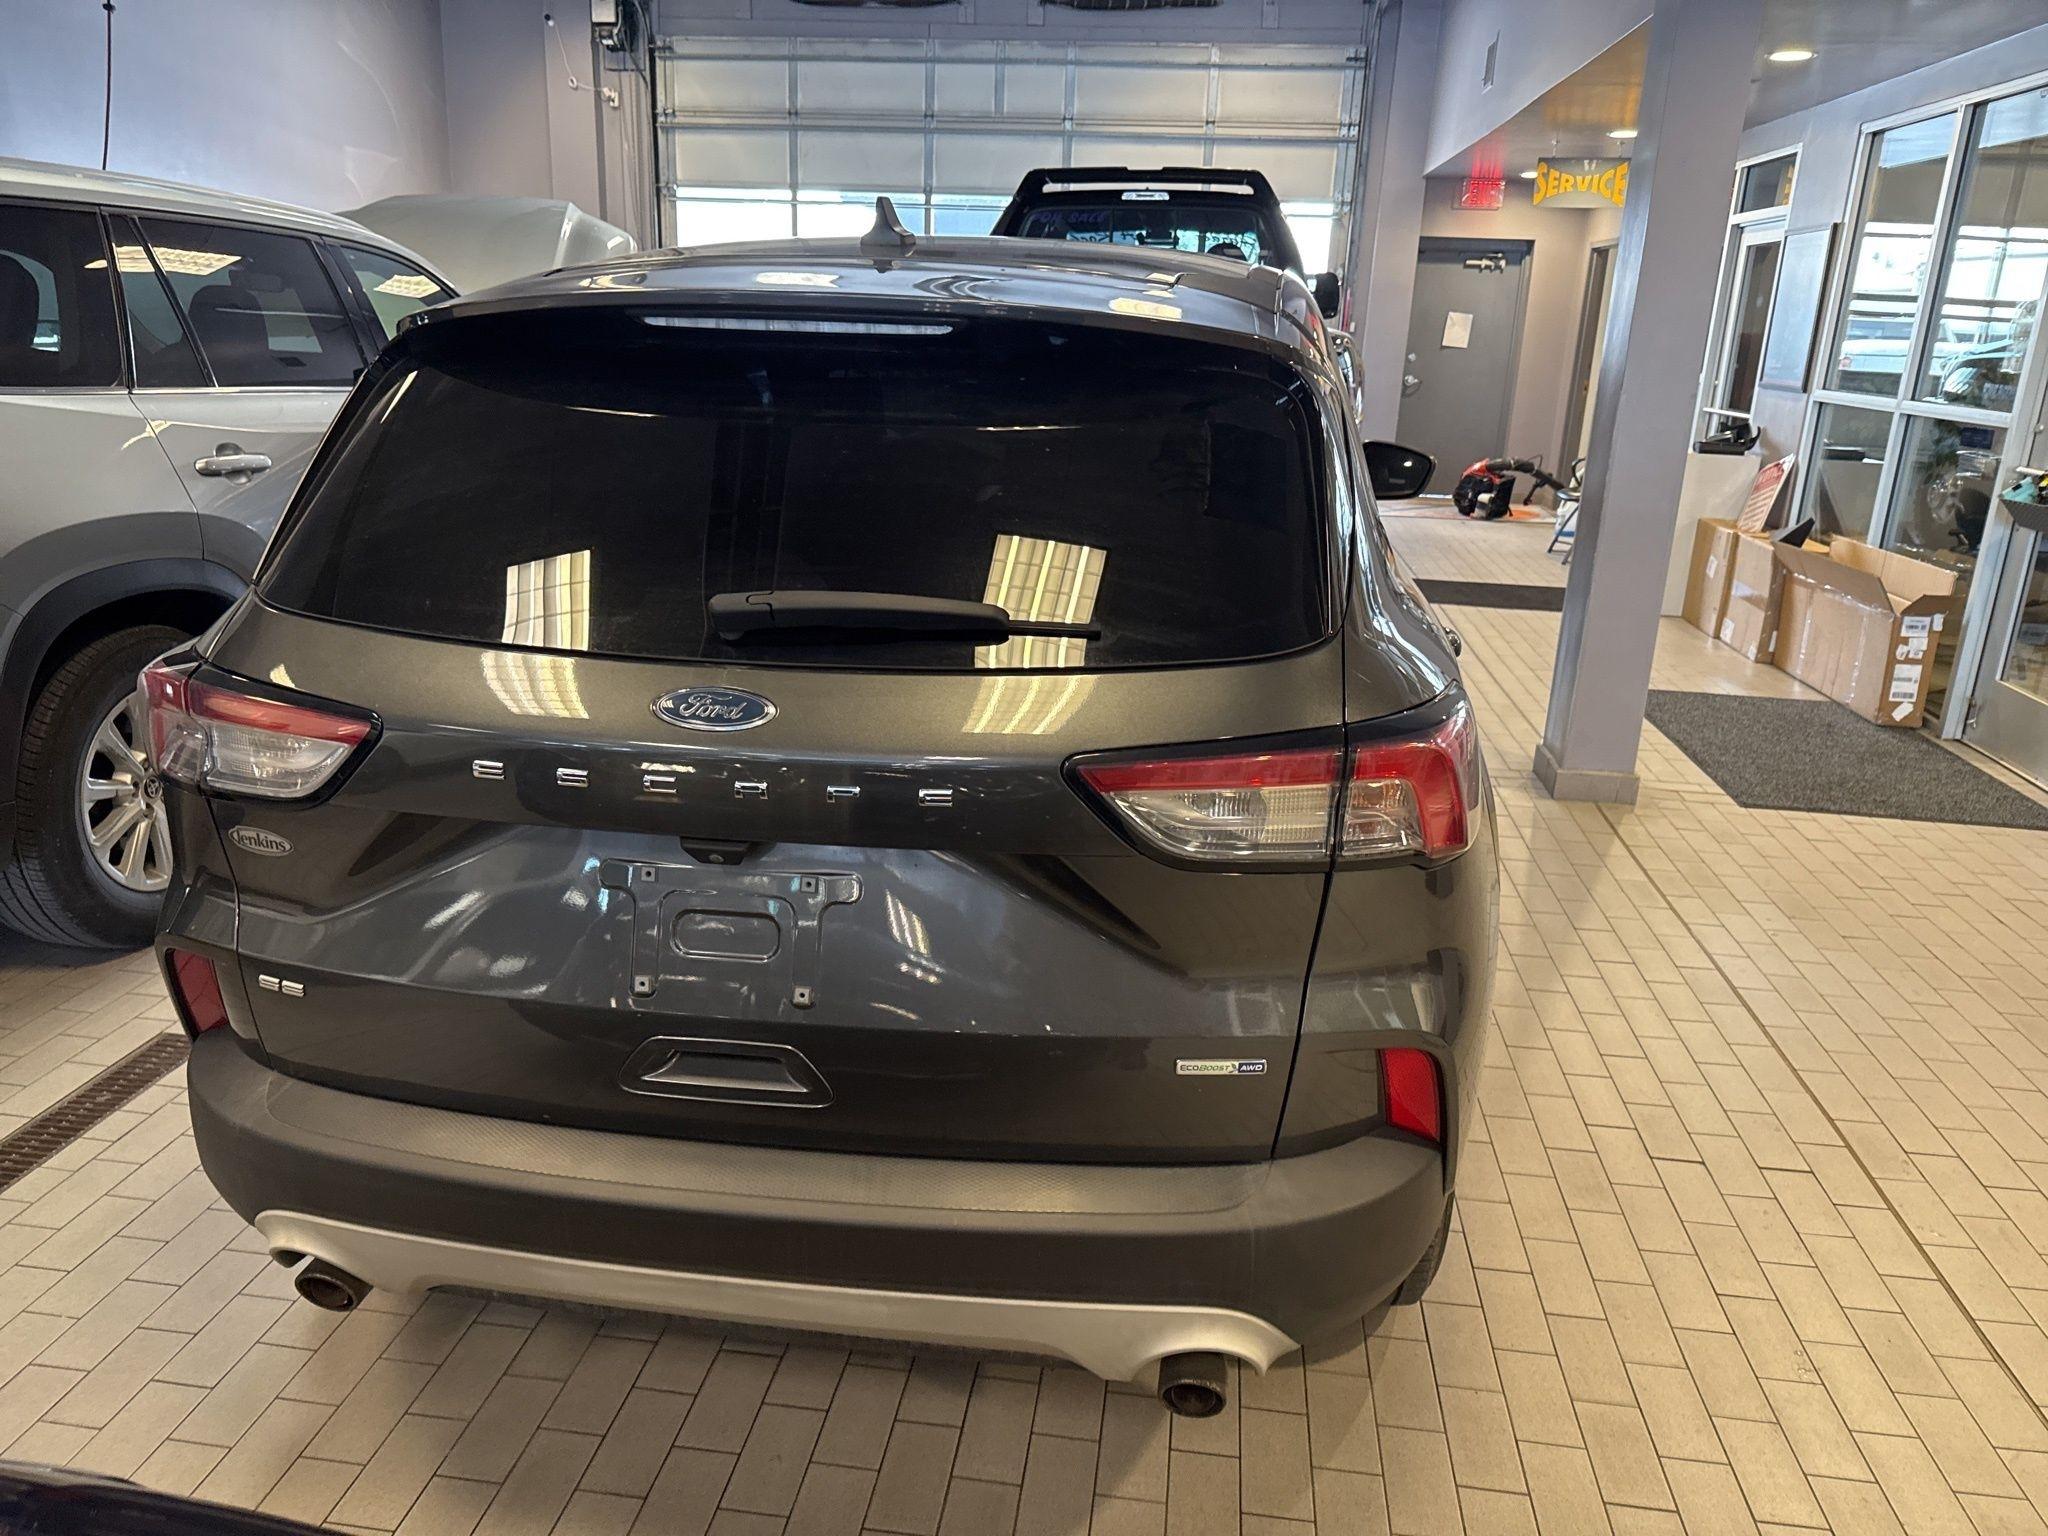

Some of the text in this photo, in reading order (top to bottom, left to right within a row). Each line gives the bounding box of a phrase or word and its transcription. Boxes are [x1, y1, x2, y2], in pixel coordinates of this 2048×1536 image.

[1533, 161, 1630, 208] SERVICE
[679, 693, 748, 719] Ford
[472, 759, 955, 807] ESCAPE
[233, 828, 287, 852] Jenkins
[258, 974, 305, 998] SE
[1240, 1063, 1263, 1072] AWD
